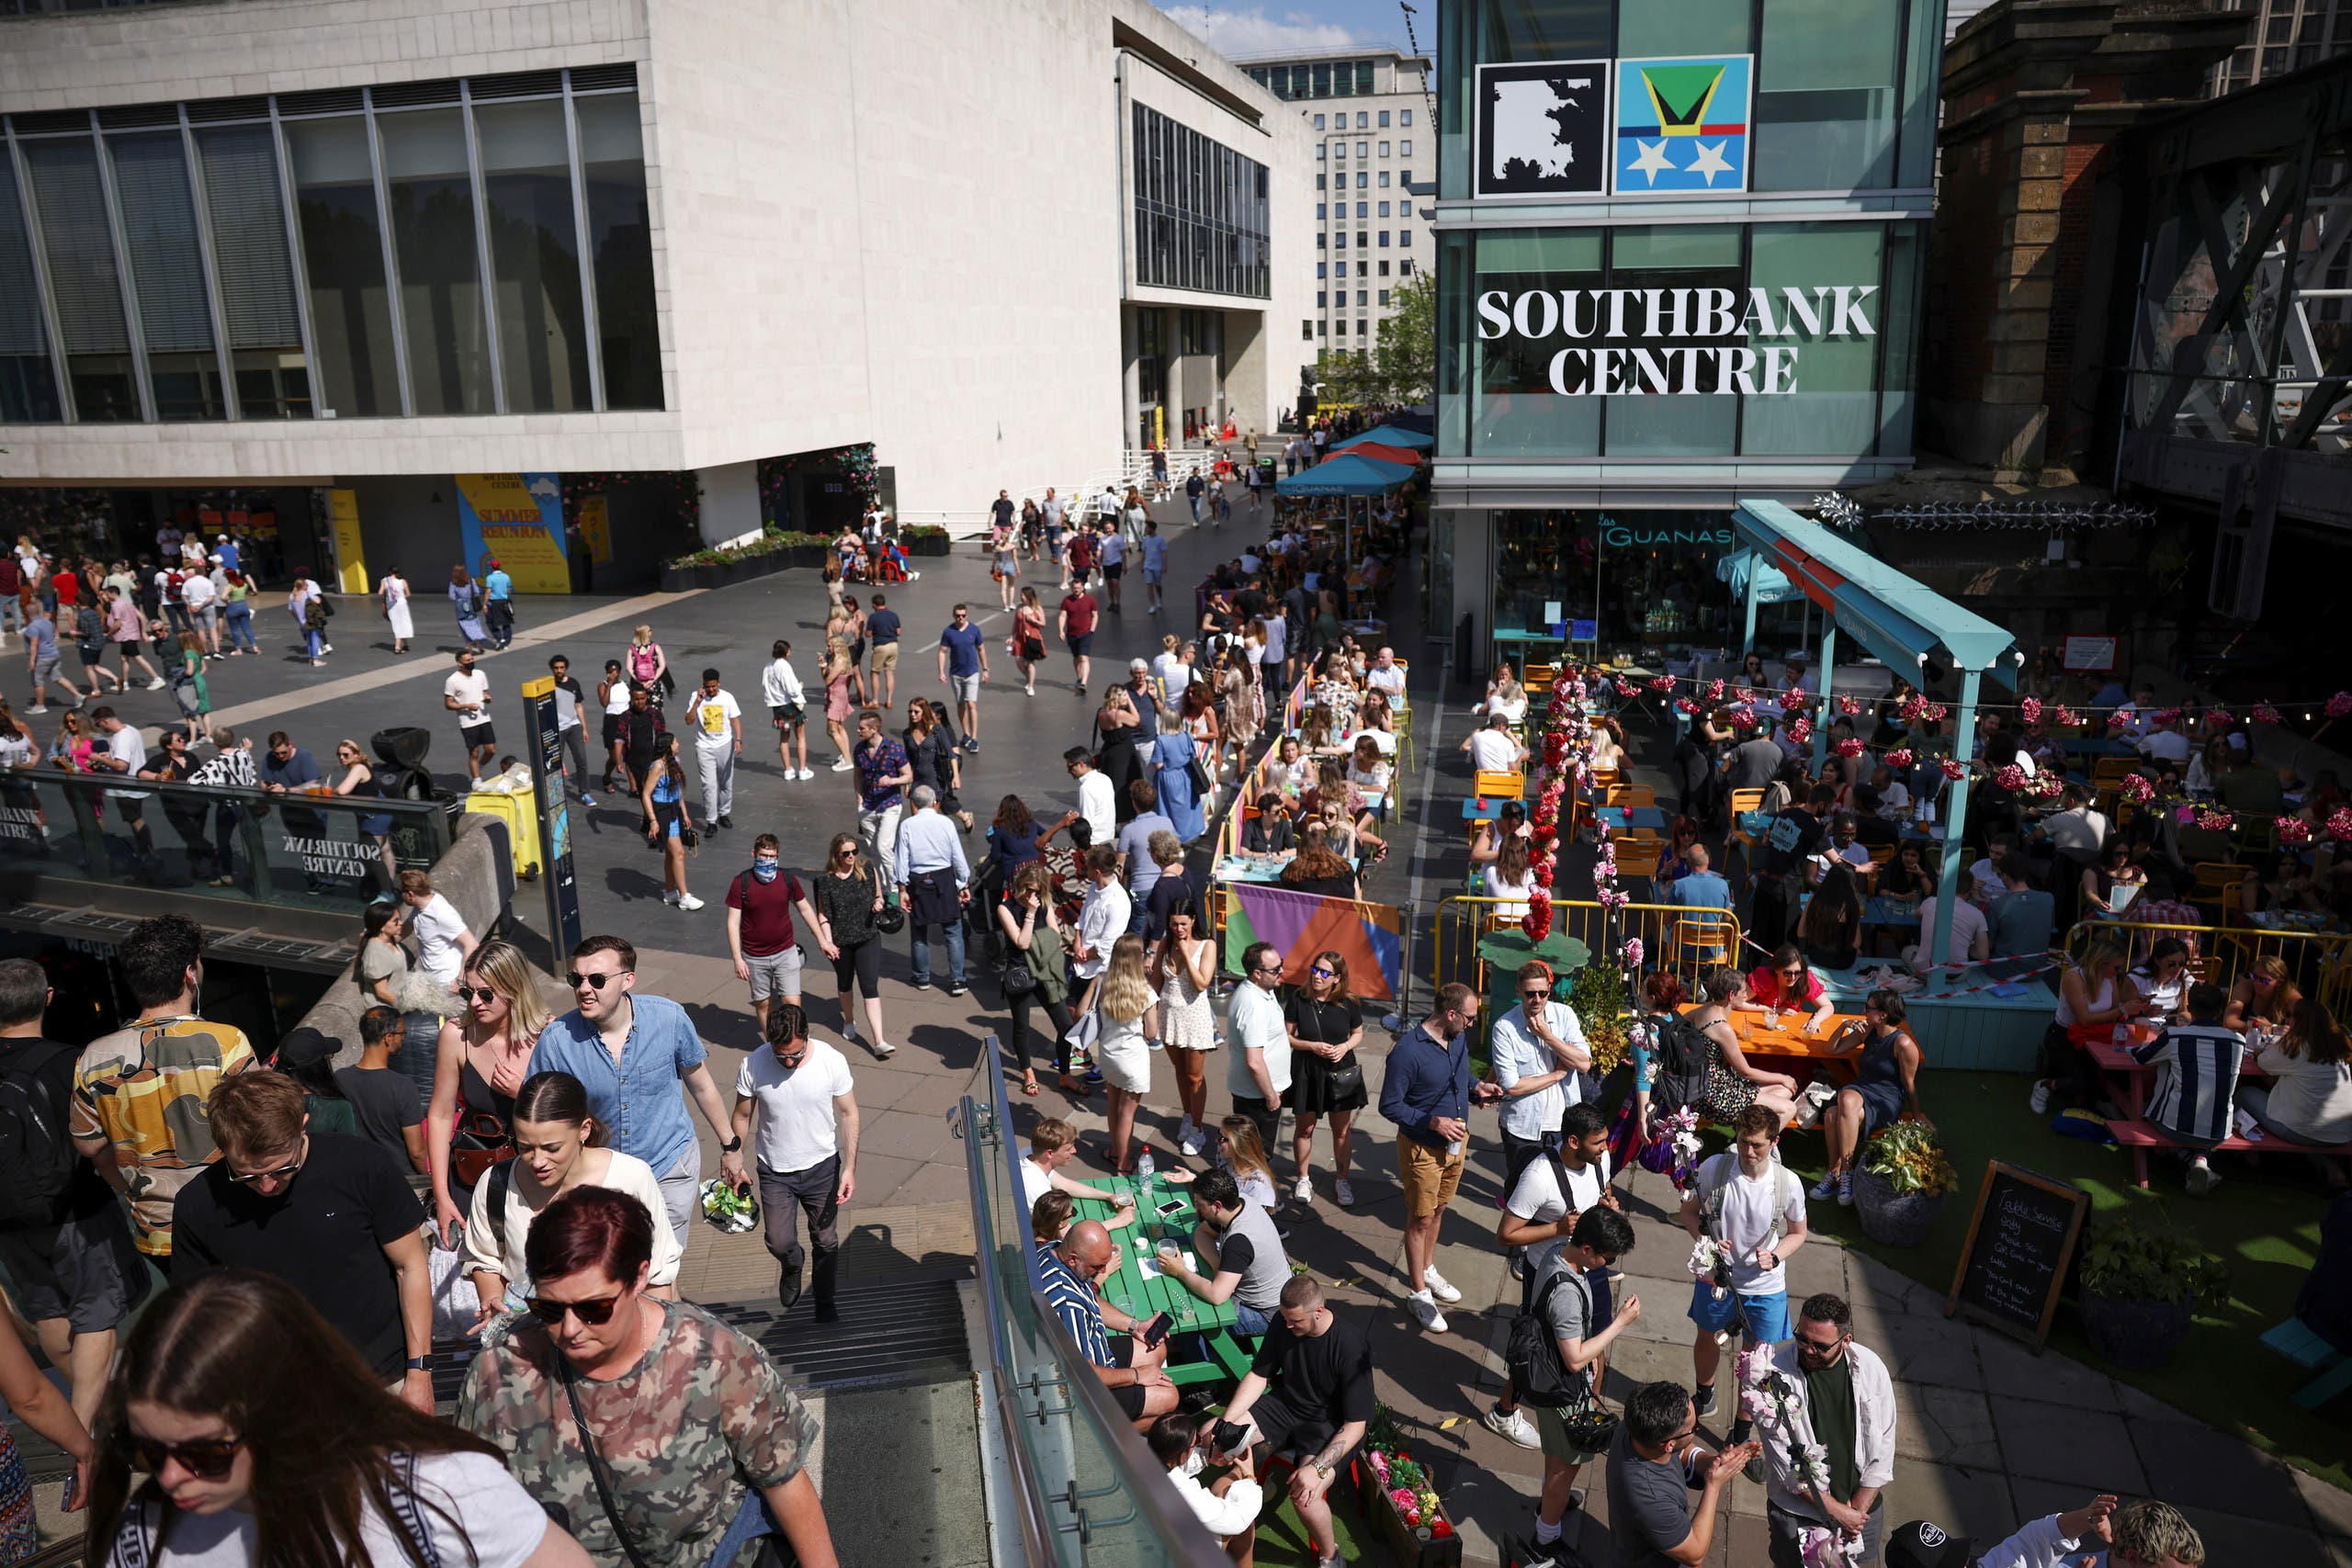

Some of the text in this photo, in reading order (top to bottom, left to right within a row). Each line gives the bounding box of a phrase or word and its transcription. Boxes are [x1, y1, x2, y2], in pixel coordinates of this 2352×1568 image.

[1476, 285, 1880, 339] SOUTHBANK
[1548, 346, 1799, 397] CENTRE
[479, 508, 543, 523] SUMMER
[1598, 512, 1616, 527] las
[481, 525, 547, 538] REUNION
[0, 807, 40, 825] BANK
[0, 821, 30, 839] TRE
[64, 937, 117, 961] waga
[1999, 1189, 2029, 1215] Table
